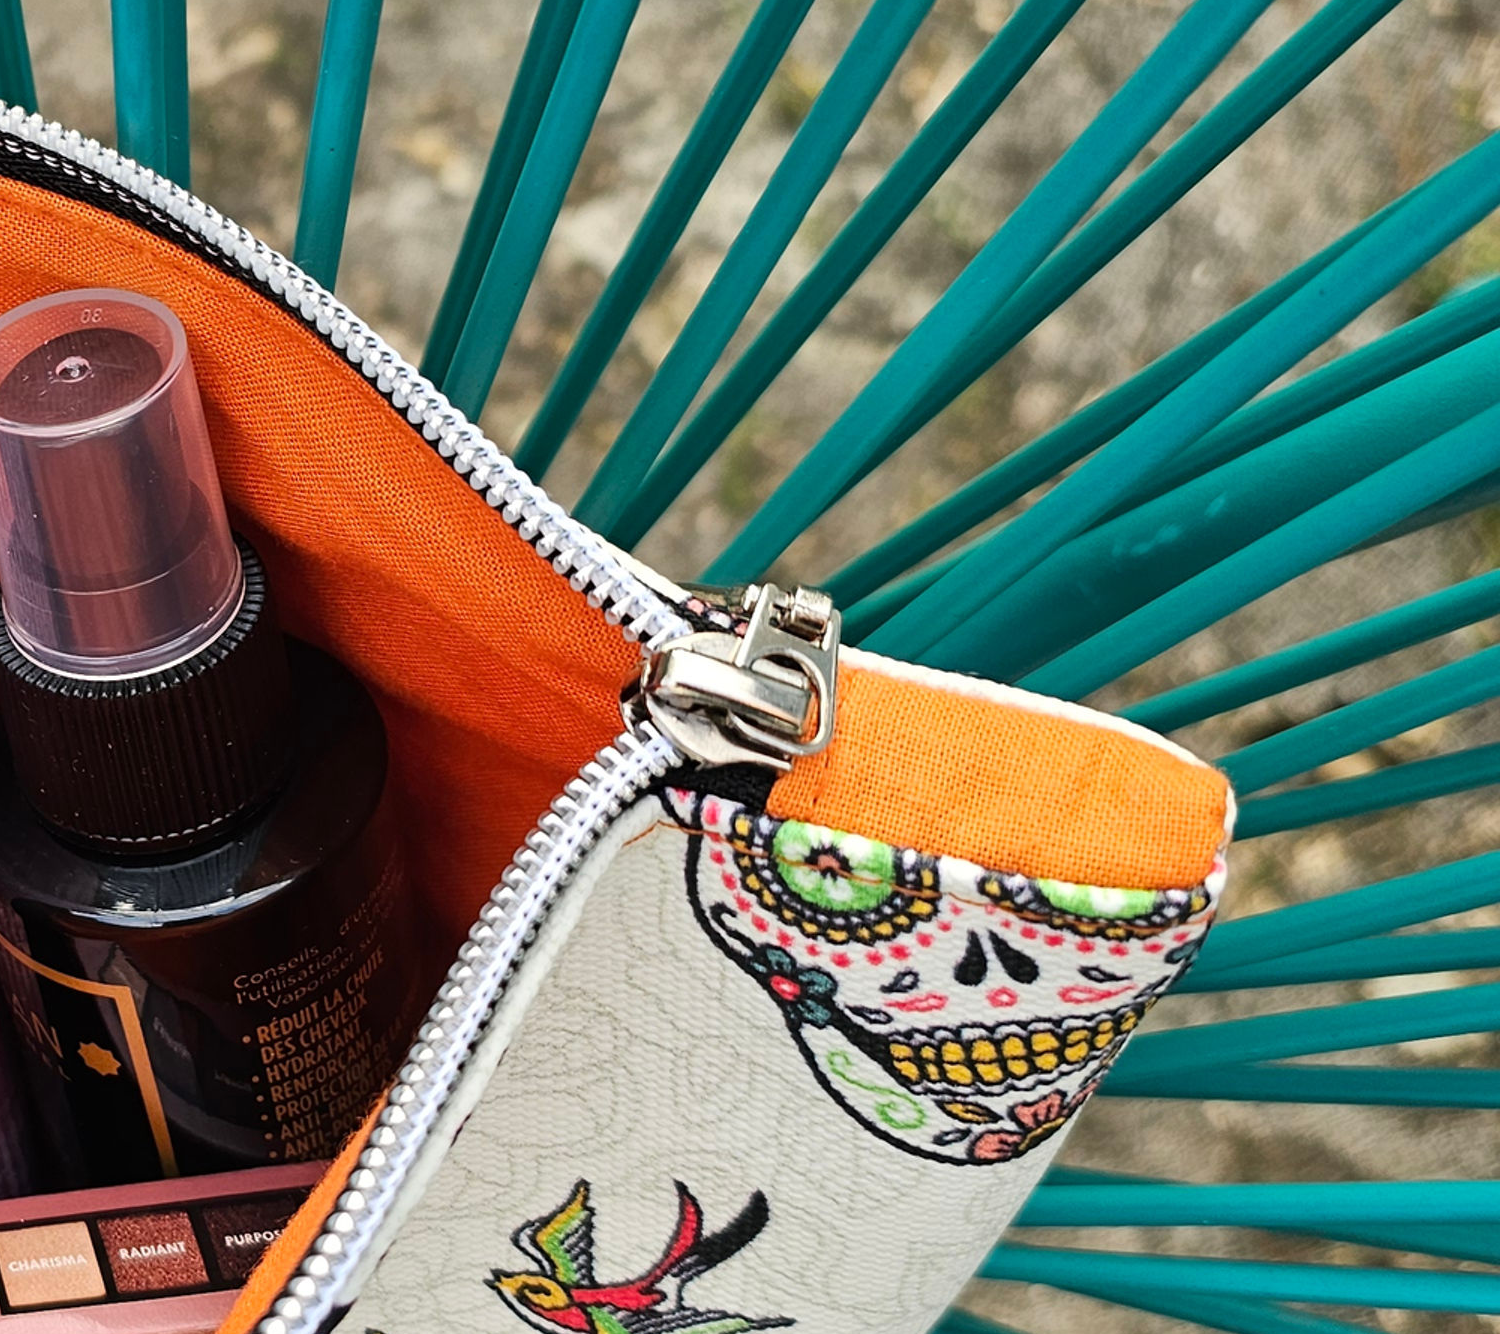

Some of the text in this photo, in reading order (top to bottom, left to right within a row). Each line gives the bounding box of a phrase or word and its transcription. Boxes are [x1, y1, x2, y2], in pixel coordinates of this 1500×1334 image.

[256, 946, 385, 1045] RÉDUIT LA CHUTE
[260, 1036, 297, 1065] DES
[299, 989, 368, 1048] CHEVEUX
[265, 1017, 361, 1084] HYDRATANT
[275, 1054, 372, 1122] PROTECTION
[8, 1253, 88, 1272] CHARISMA
[119, 1241, 187, 1261] RADIANT
[224, 1228, 285, 1247] PURPOS
